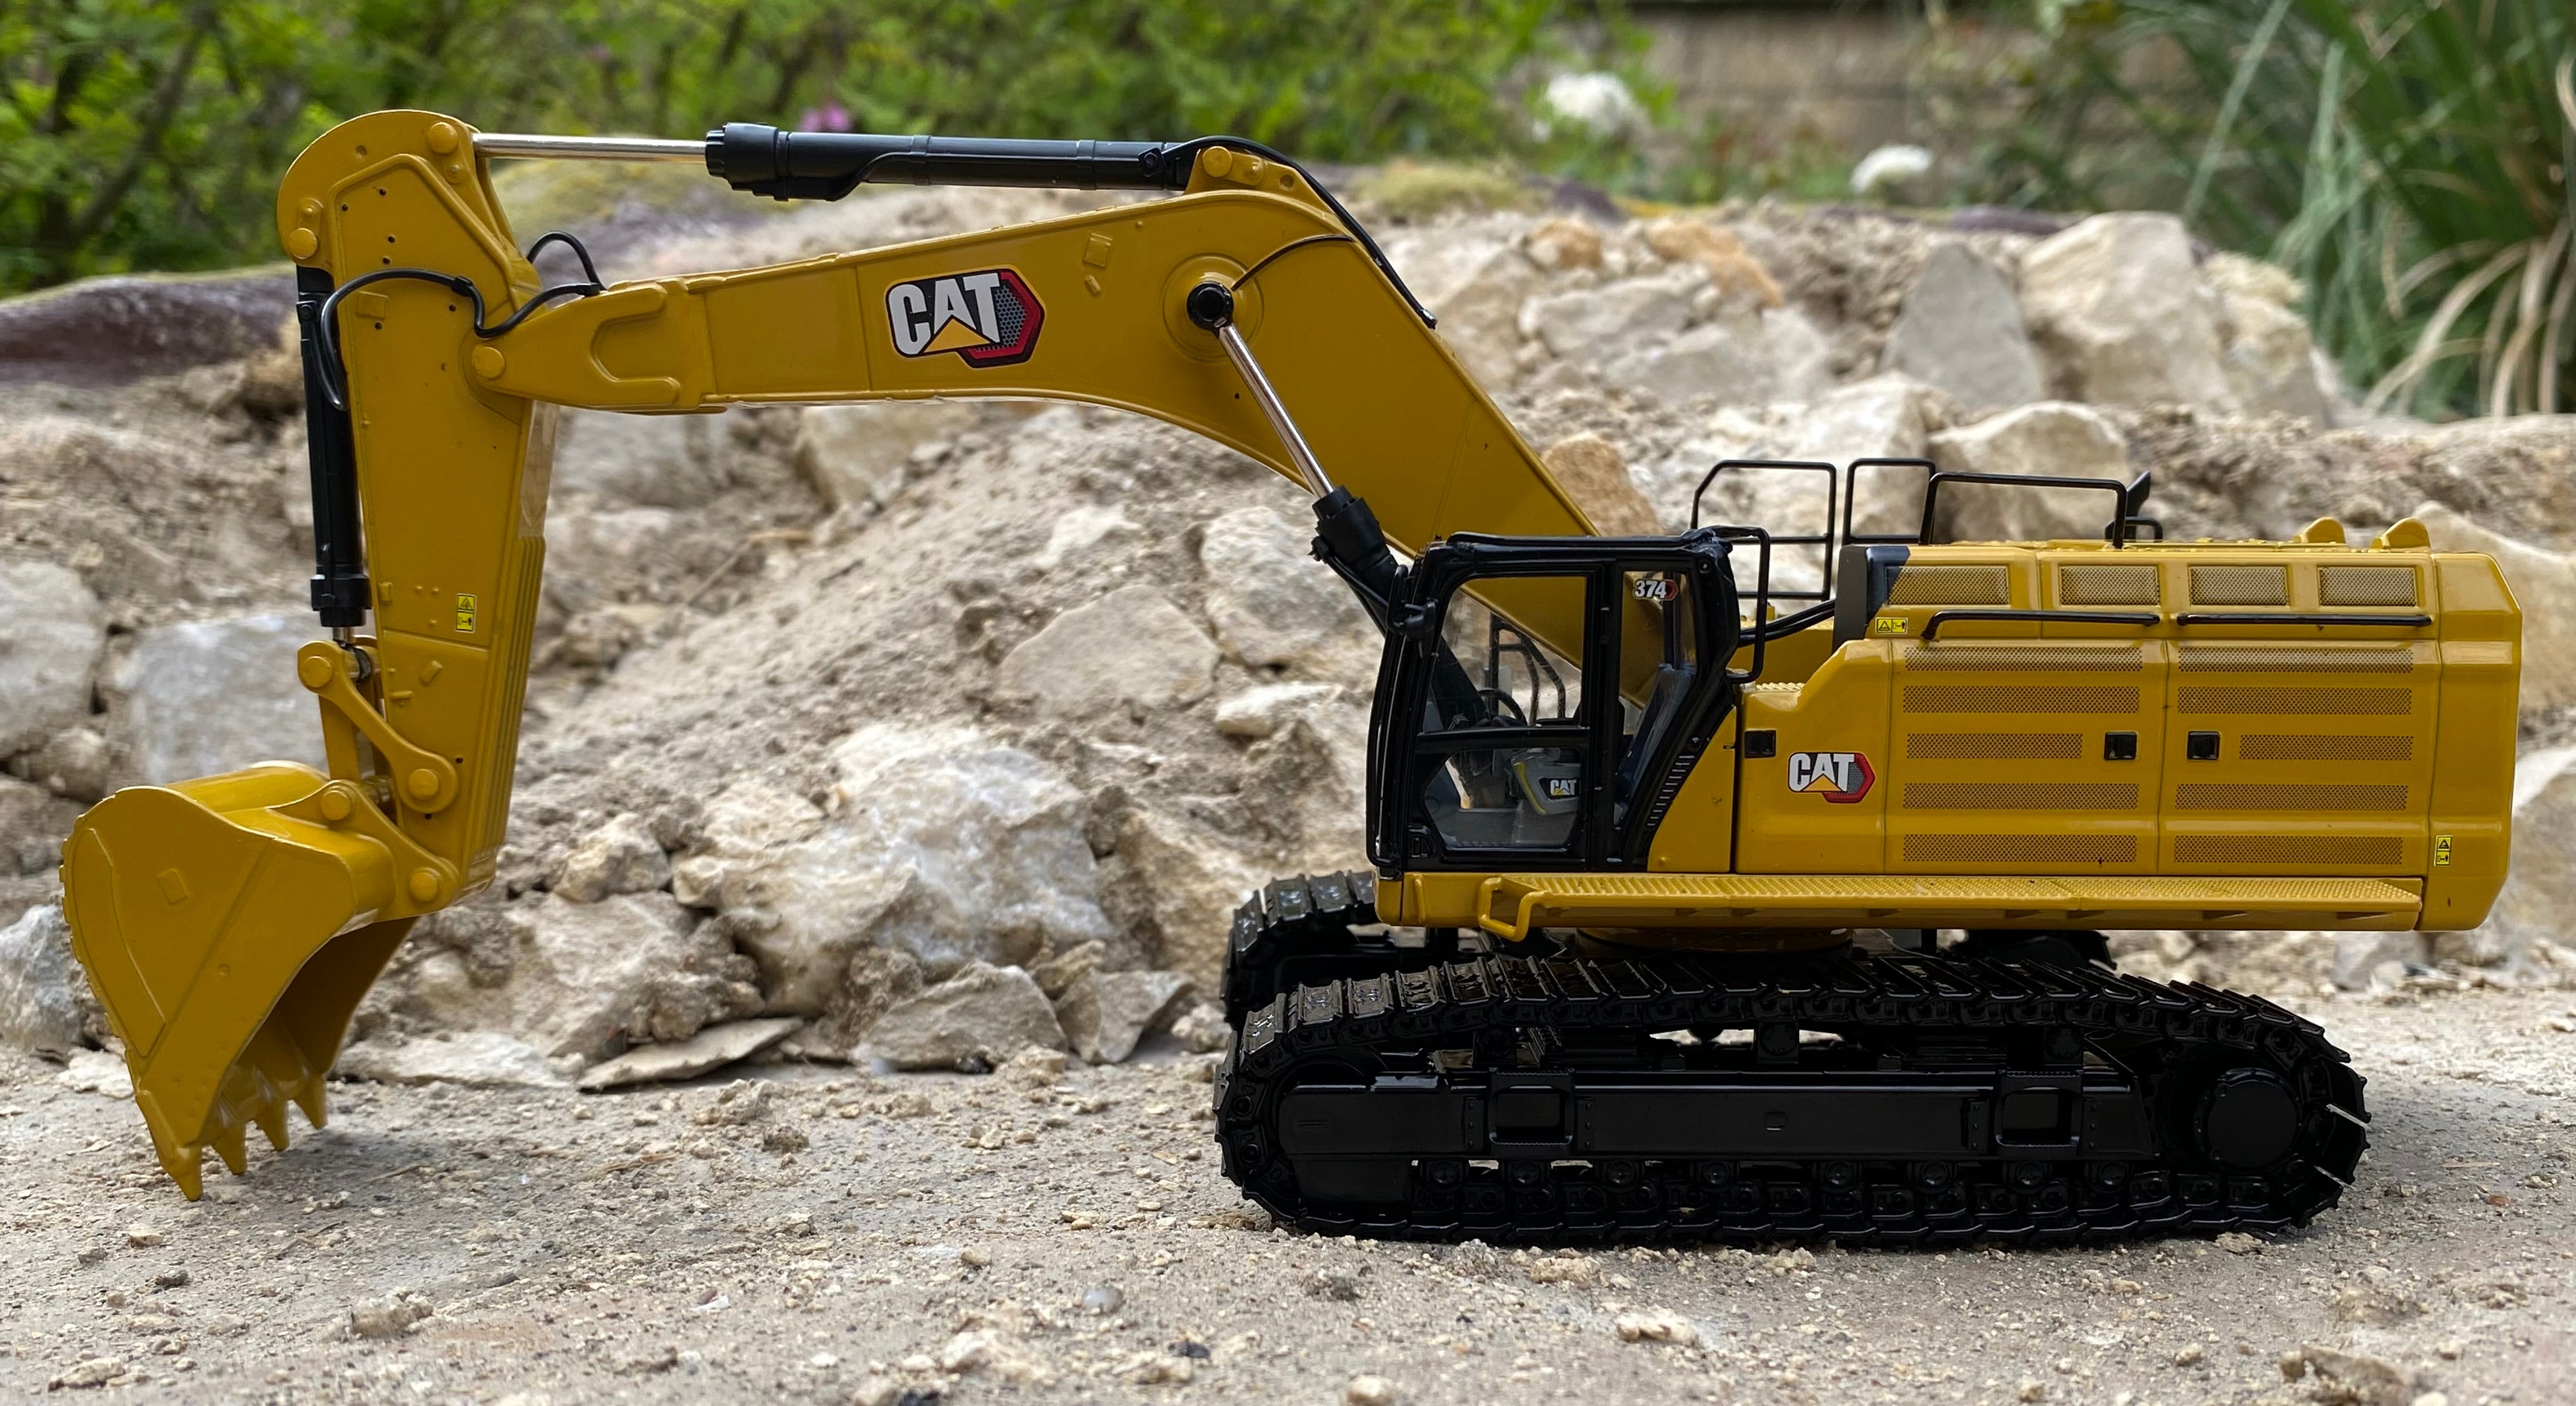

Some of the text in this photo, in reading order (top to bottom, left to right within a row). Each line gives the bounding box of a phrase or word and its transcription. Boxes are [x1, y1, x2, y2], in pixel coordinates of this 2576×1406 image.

[889, 273, 1000, 355] CAT
[1634, 580, 1666, 598] 374
[1790, 753, 1855, 792] CAT
[1550, 779, 1577, 796] CAT
